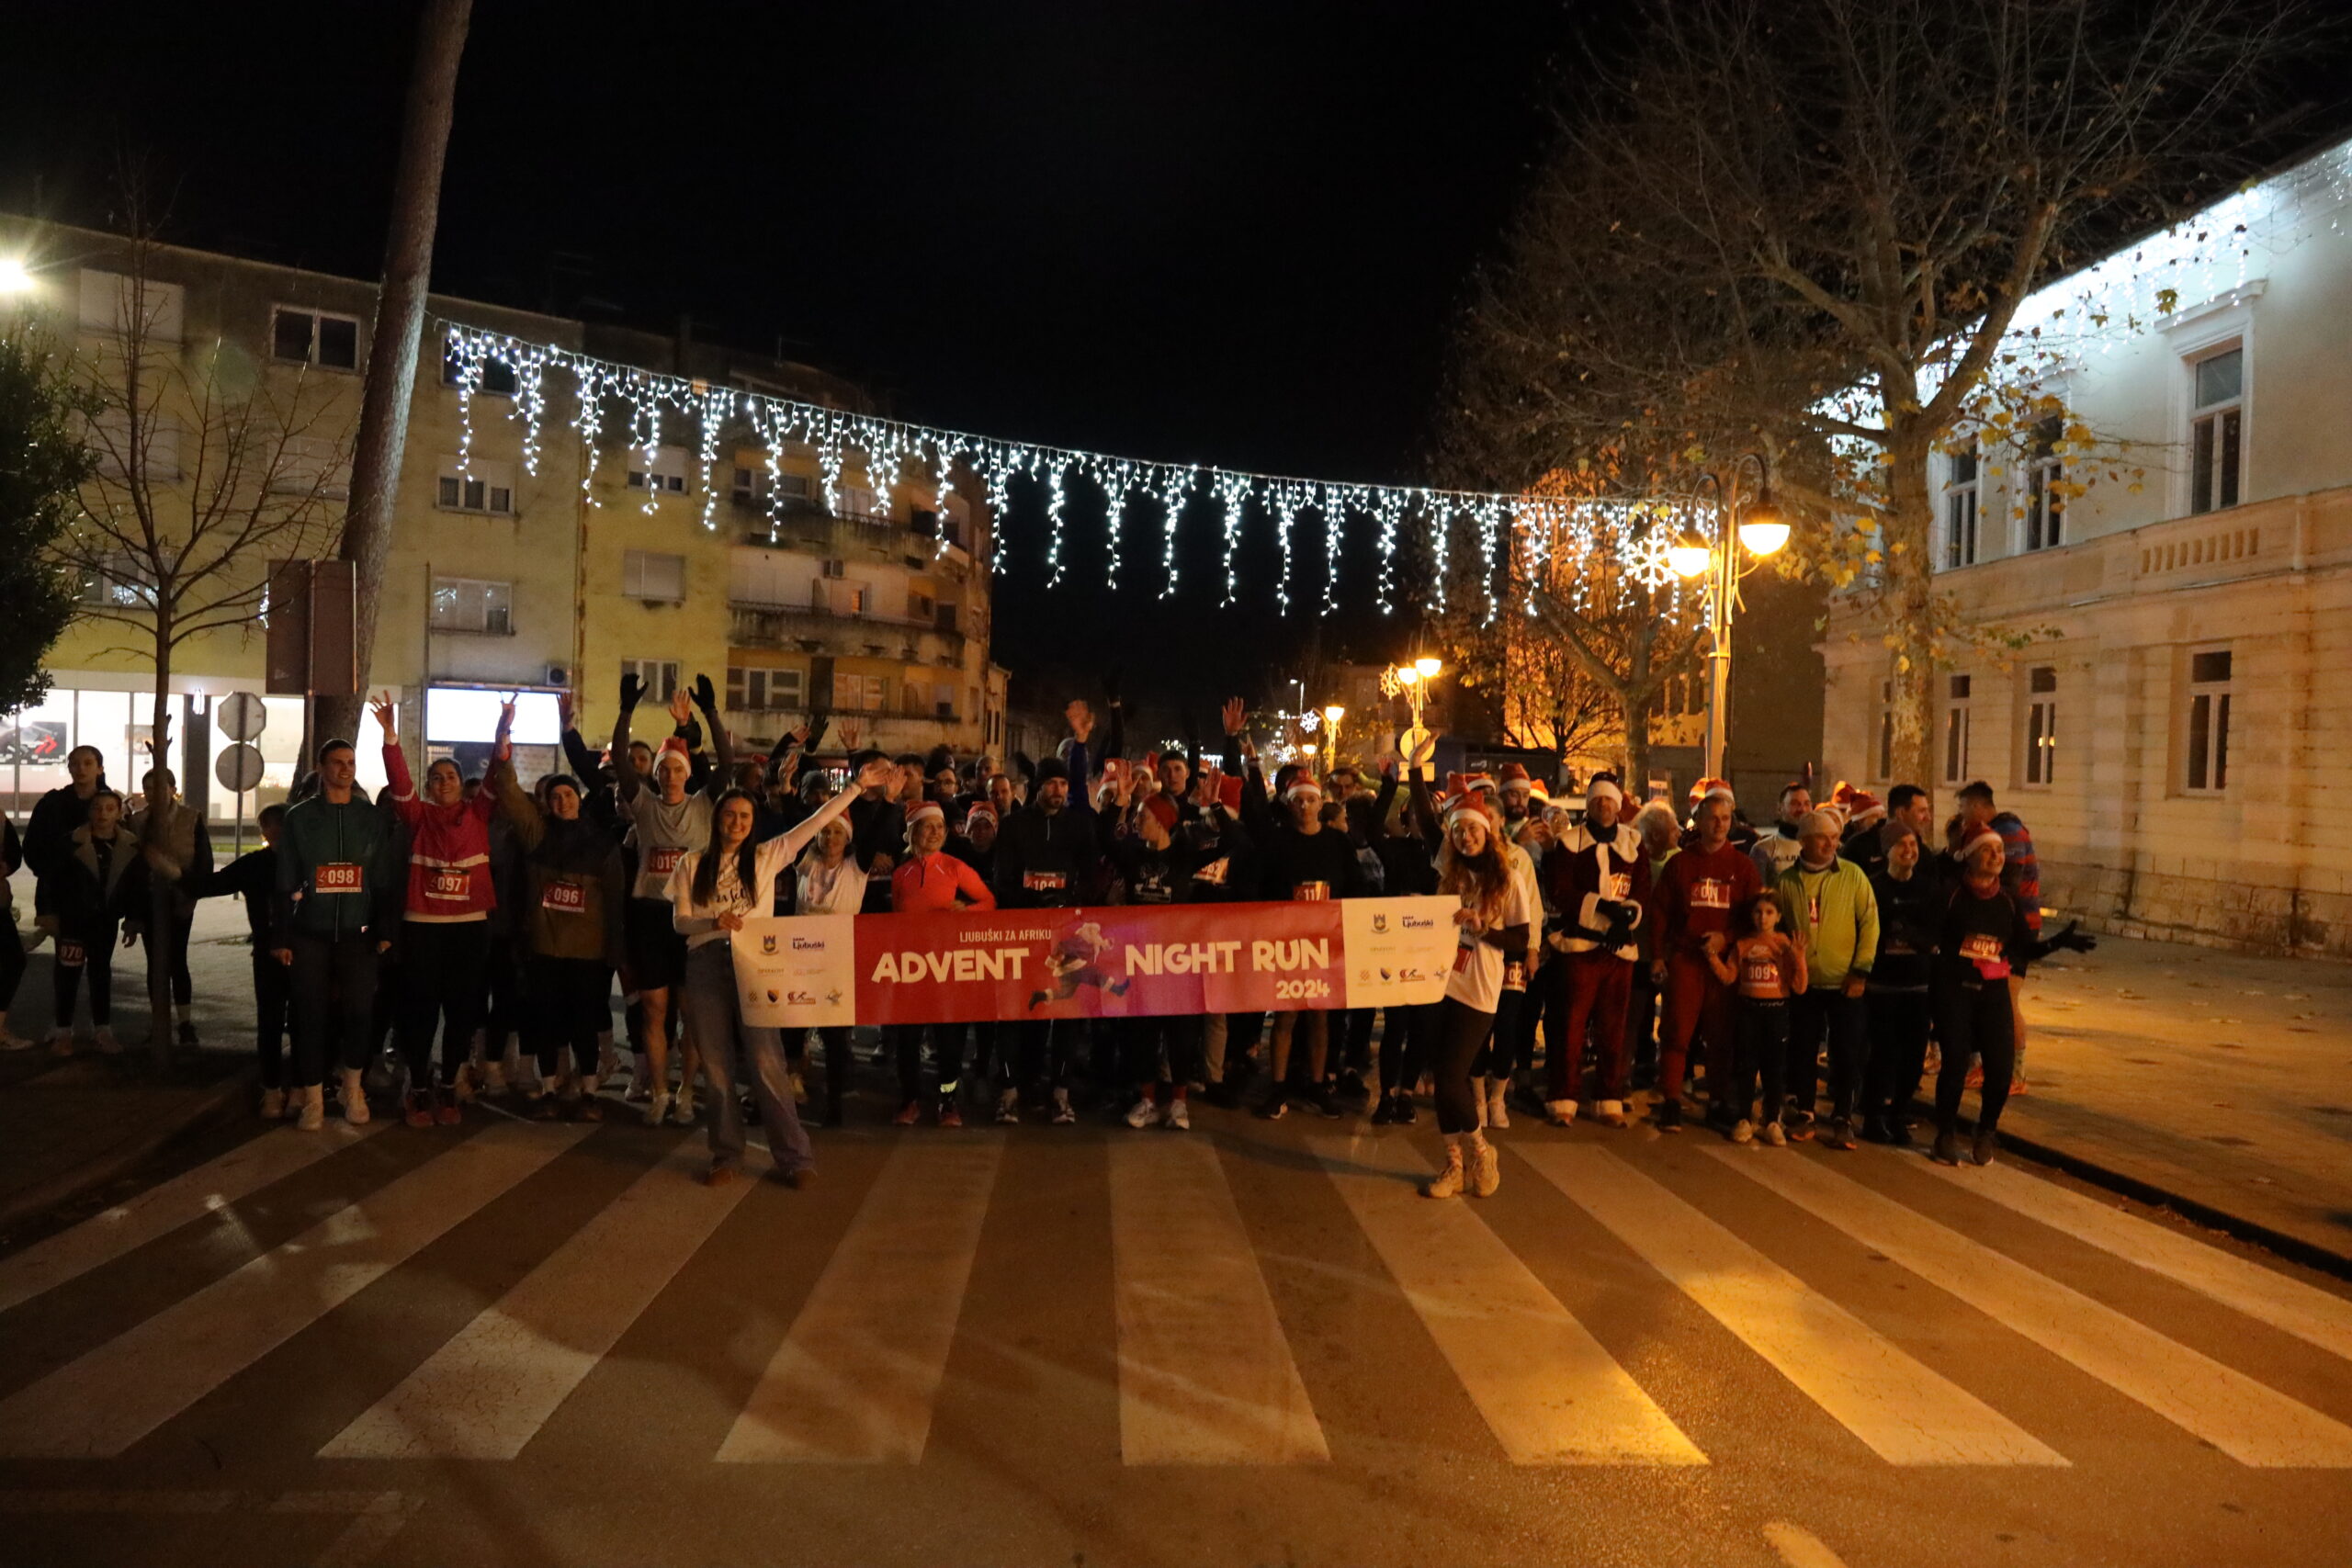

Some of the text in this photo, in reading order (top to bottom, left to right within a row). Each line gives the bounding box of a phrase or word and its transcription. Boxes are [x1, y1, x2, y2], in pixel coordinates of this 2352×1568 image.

[328, 870, 355, 884] 098
[436, 876, 462, 892] 097
[554, 887, 580, 904] 096
[959, 928, 1052, 942] LJUBUŠKI ZA AFRIKU
[61, 944, 84, 959] 070
[793, 941, 825, 950] Ljubuški
[871, 938, 1329, 984] ADVENT NIGHT RUN
[1275, 978, 1330, 999] 2024
